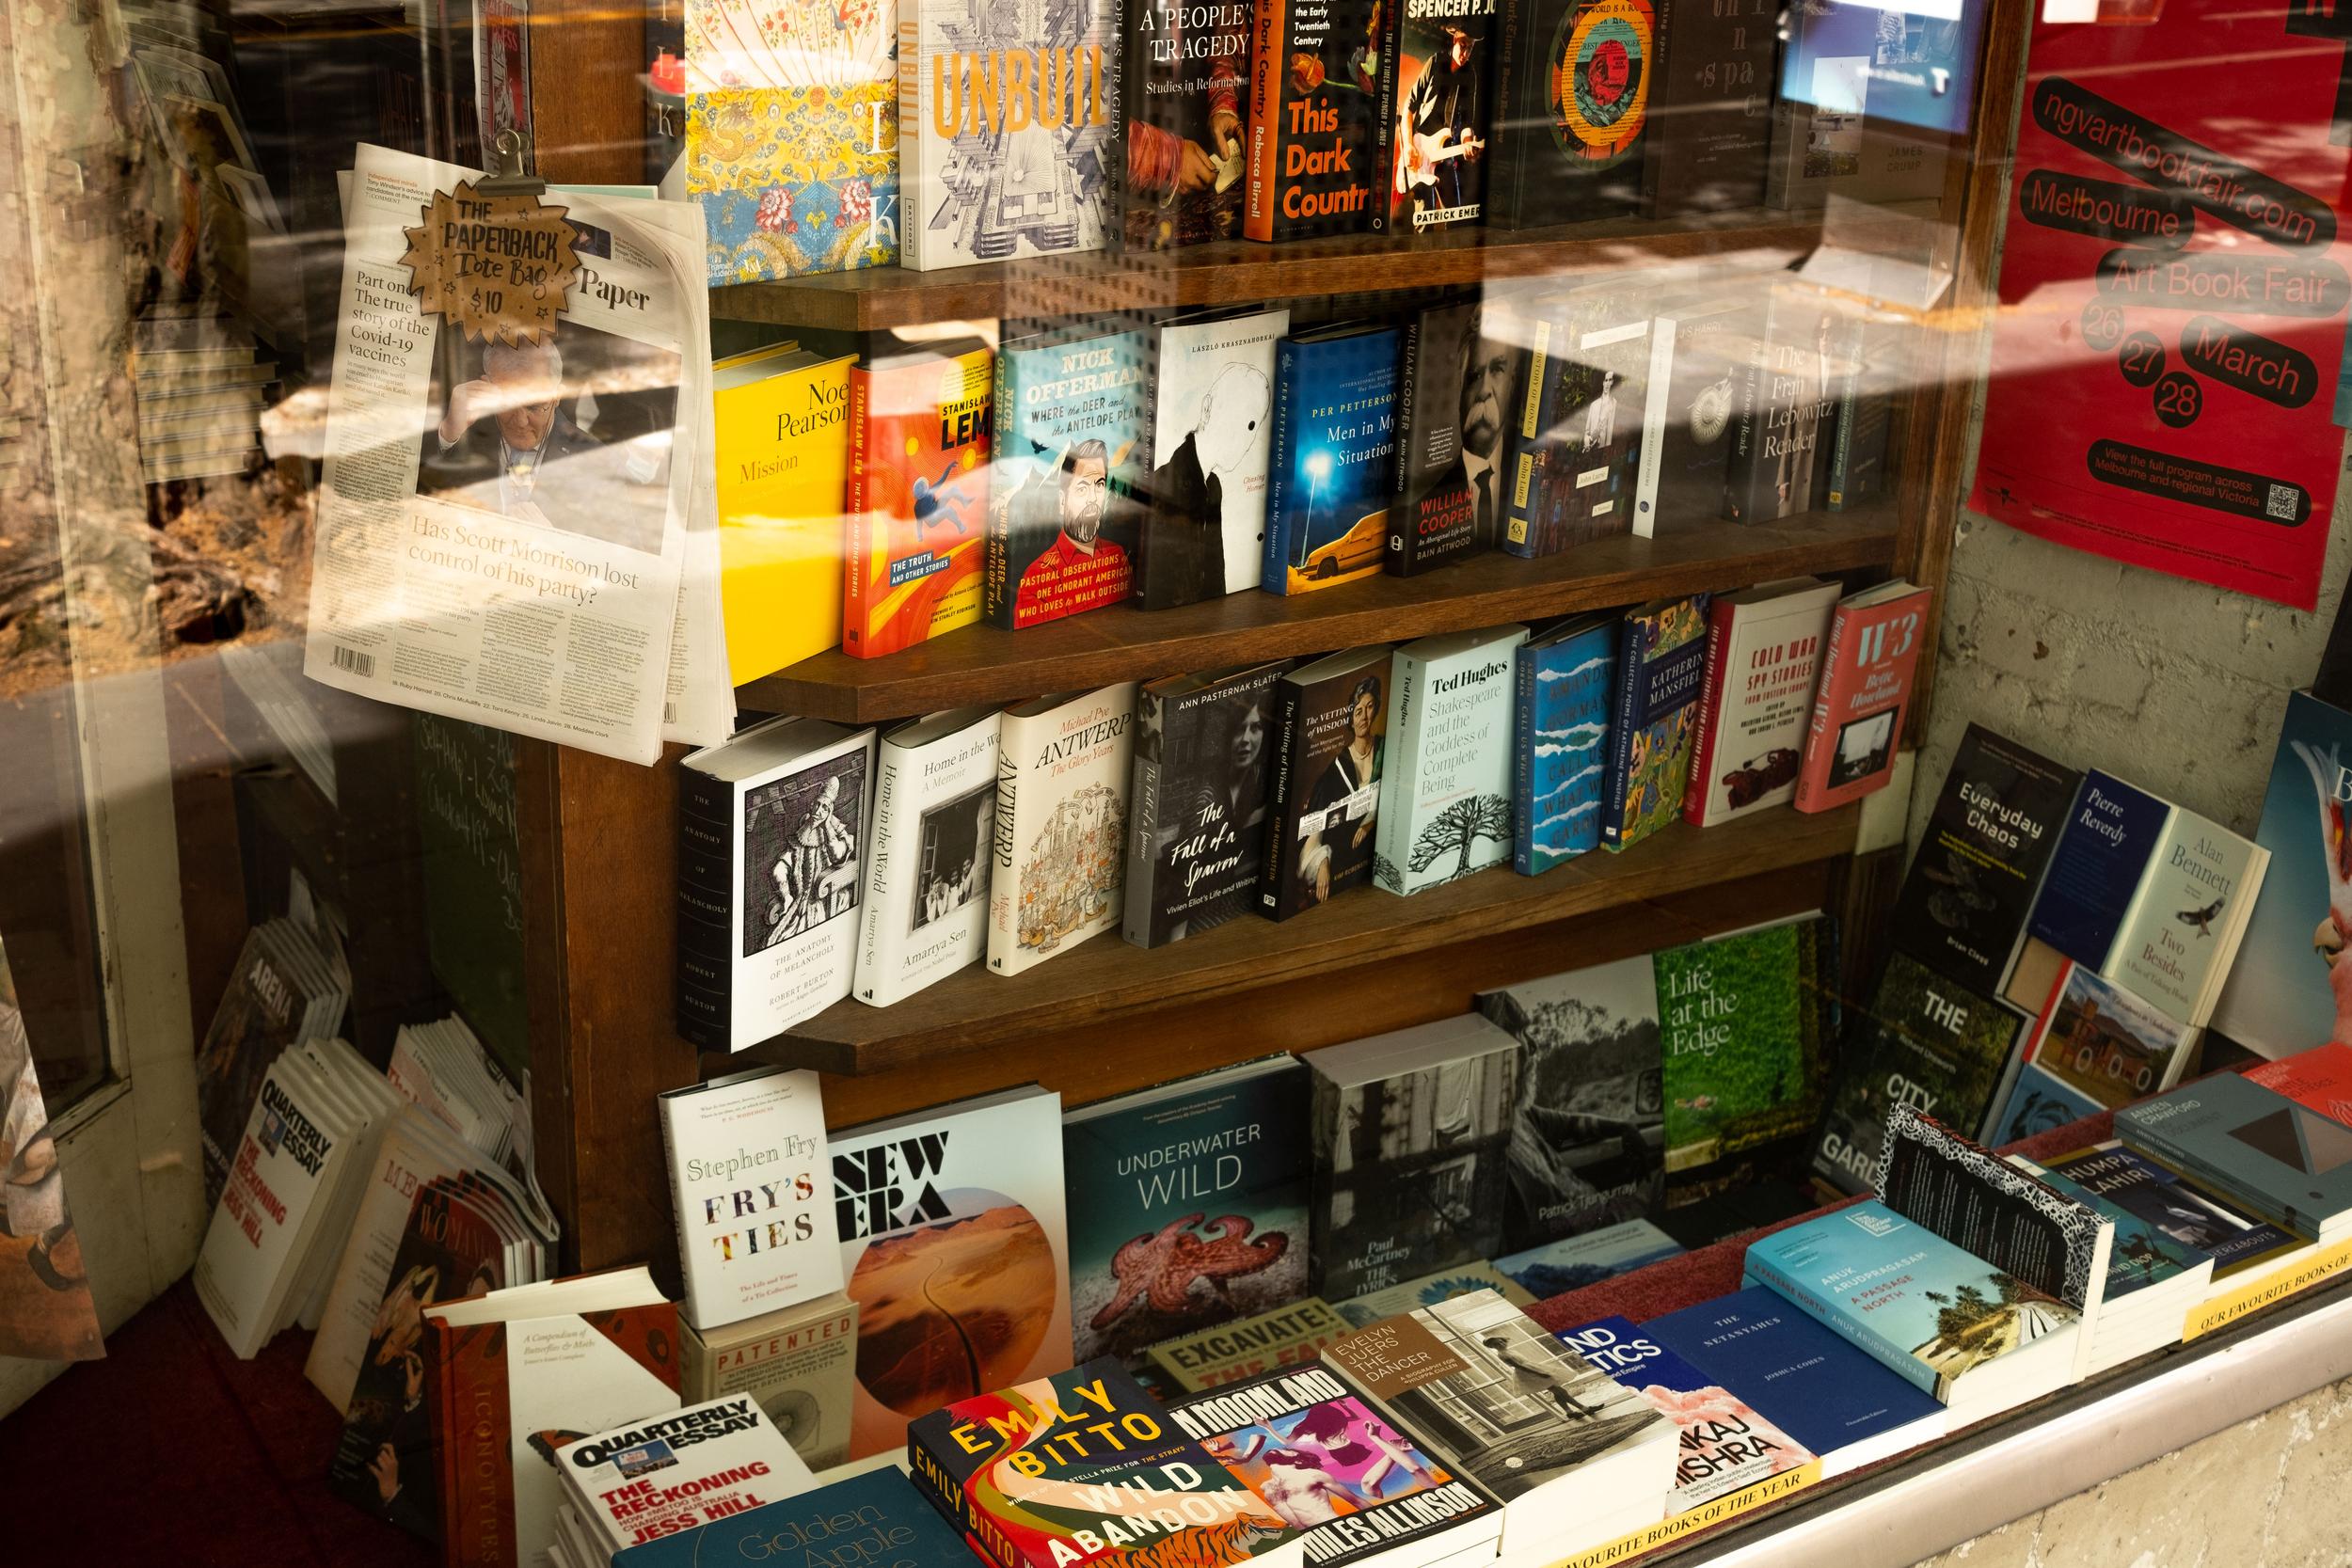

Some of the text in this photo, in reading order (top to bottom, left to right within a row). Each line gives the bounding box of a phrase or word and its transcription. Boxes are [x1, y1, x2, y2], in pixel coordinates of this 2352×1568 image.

[1295, 21, 1330, 32] Twentieth
[1408, 0, 1482, 19] SPENCER P.
[1151, 32, 1249, 61] TRAGEDY
[1294, 35, 1323, 47] Century
[1146, 74, 1249, 94] Studies in Reformation
[1288, 97, 1339, 135] This
[1250, 126, 1264, 218] Rebecca Birrell
[1285, 139, 1352, 177] Dark
[2044, 92, 2316, 244] ngvartbookfair.com
[458, 200, 492, 223] THE
[2032, 180, 2180, 238] Melbourne
[444, 223, 558, 263] PAPERBACK
[357, 271, 384, 290] Part
[580, 267, 650, 312] Paper
[2111, 260, 2331, 303] Art Book Fair
[356, 289, 412, 313] The true
[470, 291, 502, 314] $10
[351, 325, 414, 354] Covid-19
[353, 309, 429, 336] story of the
[2084, 306, 2119, 340] 26
[349, 343, 406, 367] vaccines
[1061, 347, 1114, 374] NICK
[2123, 340, 2161, 373] 27
[2194, 325, 2300, 395] March
[1026, 364, 1143, 404] OFFERMAN
[2157, 379, 2197, 417] 28
[1031, 395, 1126, 423] WHERE the DEER and
[1311, 392, 1398, 418] PER PETTERSON
[942, 406, 993, 451] LEM
[1052, 423, 1065, 437] the
[1066, 413, 1114, 433] ANTELOPE
[1327, 425, 1355, 443] Men
[1362, 421, 1374, 434] in
[1337, 444, 1393, 467] Situation
[2106, 447, 2252, 492] View the full program across
[2095, 457, 2259, 506] Melbourne and regional Victoria
[1421, 489, 1473, 514] WILLIAM
[1419, 505, 1472, 535] COOPER
[413, 515, 639, 590] Has Scott Morrison lost
[892, 553, 932, 573] THE TRUTH
[408, 545, 597, 607] control of his party?
[892, 560, 948, 584] AND OTHER STORIES
[1752, 636, 1817, 669] COLD WAR
[1431, 660, 1508, 695] Ted Hughes
[1747, 661, 1813, 690] SPY STORIES
[1306, 705, 1354, 726] The VETTING
[1429, 684, 1502, 719] Shakespeare
[1035, 712, 1132, 769] ANTWERP
[1308, 717, 1349, 737] of WISDOM
[1425, 722, 1489, 758] Goddess of
[1427, 713, 1470, 738] and the
[1422, 747, 1478, 776] Complete
[1422, 774, 1455, 797] Being
[2087, 787, 2124, 817] Pierre
[1197, 802, 1225, 828] The
[1958, 781, 2043, 839] Everyday
[1171, 827, 1235, 866] Fall of a
[1965, 812, 2018, 848] Chaos
[2080, 811, 2126, 846] Reverdy
[2193, 835, 2224, 864] Alan
[1184, 850, 1244, 896] Sparrow
[2169, 844, 2231, 895] Bennett
[903, 927, 967, 968] Amartya Sen
[2160, 927, 2185, 957] Two
[1670, 963, 1713, 999] Life
[2142, 943, 2185, 983] Besides
[1672, 990, 1740, 1027] at the
[1924, 990, 1968, 1034] THE
[1673, 1022, 1732, 1056] Edge
[261, 1079, 331, 1156] QUARTERLY
[282, 1130, 324, 1177] ESSAY
[687, 1134, 817, 1181] Stephen Fry
[832, 1131, 949, 1197] NEW
[1118, 1123, 1262, 1176] UNDERWATER
[704, 1173, 813, 1226] FRY'S
[1137, 1155, 1243, 1212] WILD
[836, 1180, 952, 1243] ERA
[714, 1213, 813, 1262] TIES
[1820, 1267, 1856, 1286] ANUK
[1835, 1252, 1927, 1294] ARUDPRAGASAM
[1861, 1275, 1914, 1298] PASSAGE
[2201, 1253, 2351, 1329] OUR FAVOURITE BOOKS OF
[1862, 1291, 1905, 1312] NORTH
[718, 1318, 851, 1370] PATENTED
[1168, 1304, 1335, 1369] EXCAVATE!
[1336, 1325, 1396, 1356] EVELYN
[1348, 1338, 1399, 1365] JUERS
[1355, 1354, 1391, 1372] THE
[1366, 1352, 1432, 1382] DANCER
[949, 1378, 1119, 1454] EMILY
[1197, 1369, 1347, 1437] MOONLAND
[572, 1399, 749, 1469] QUARTERLY
[666, 1413, 761, 1449] ESSAY
[1008, 1411, 1163, 1480] BITTO
[598, 1479, 654, 1506] THE
[610, 1461, 771, 1522] RECKONING
[1073, 1462, 1202, 1513] WILD
[631, 1491, 767, 1547] JESS HILL
[1047, 1484, 1251, 1568] ABANDON
[1374, 1481, 1485, 1546] ALLINSON
